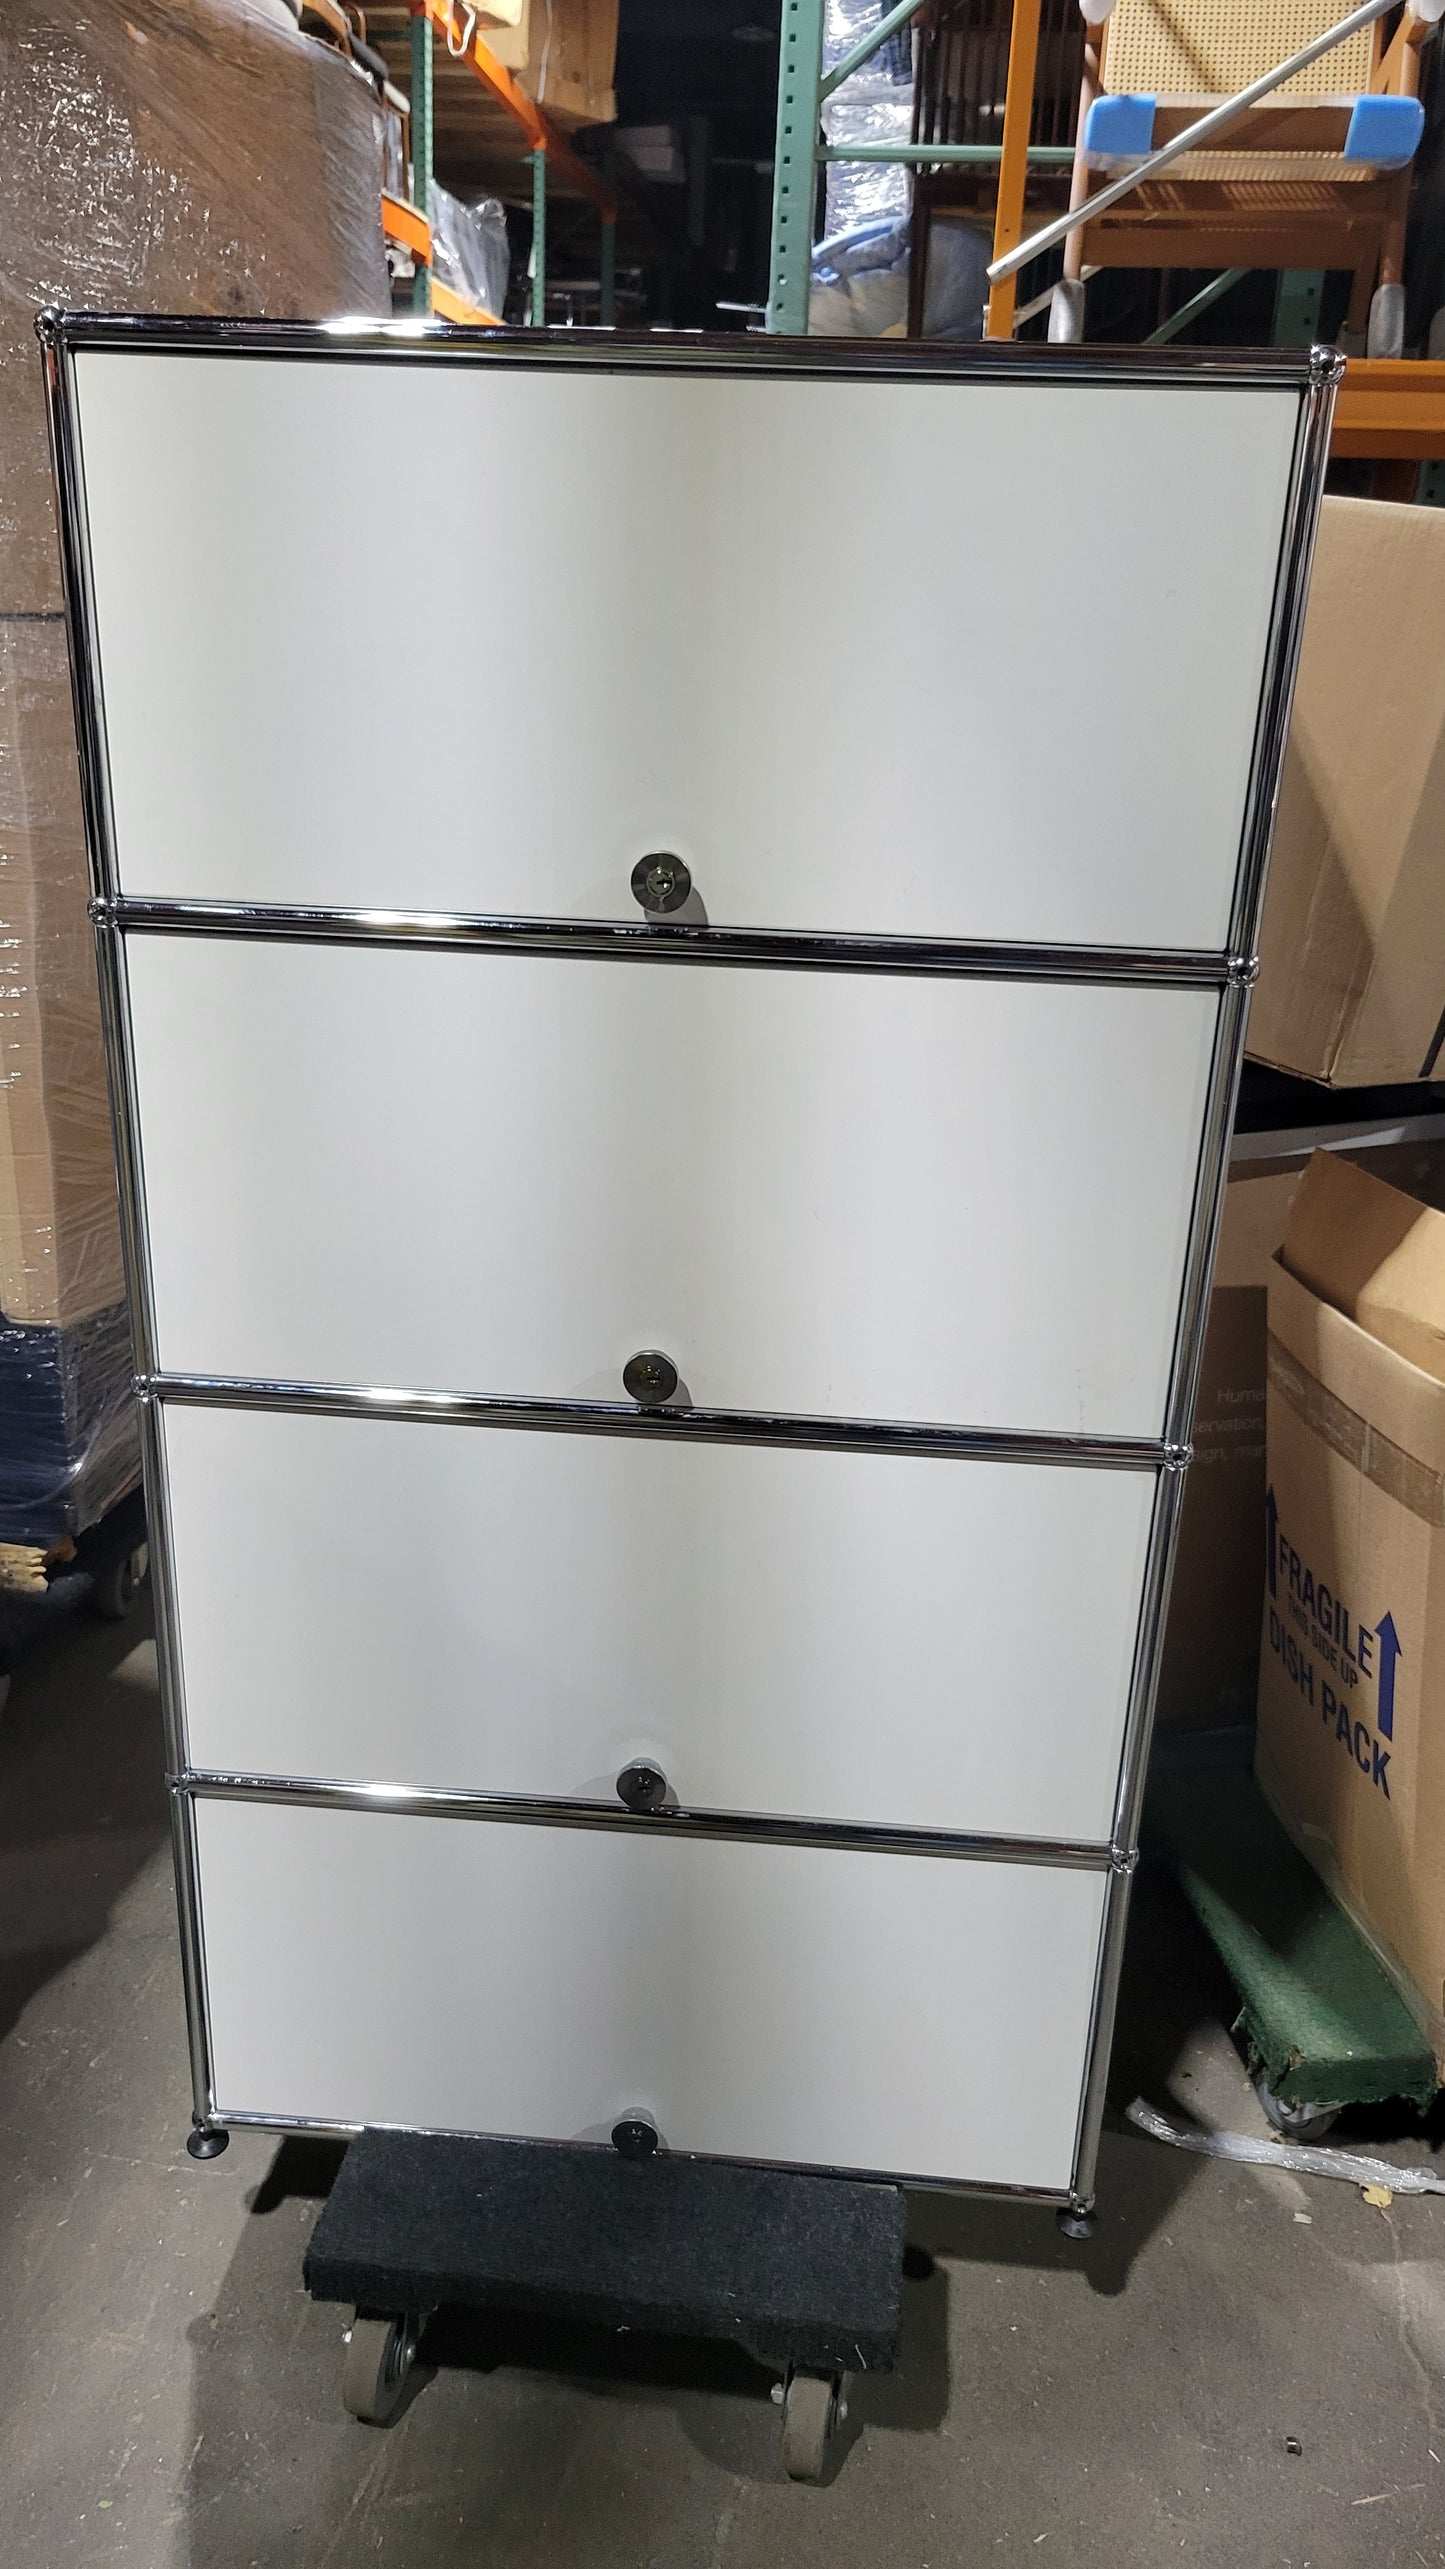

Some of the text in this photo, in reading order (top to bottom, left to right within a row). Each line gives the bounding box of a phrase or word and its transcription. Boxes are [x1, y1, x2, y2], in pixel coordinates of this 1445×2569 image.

[1279, 1533, 1373, 1679] FRAGILE
[1286, 1592, 1358, 1689] THIS SIDE UP
[1269, 1604, 1391, 1800] DISH PACK
